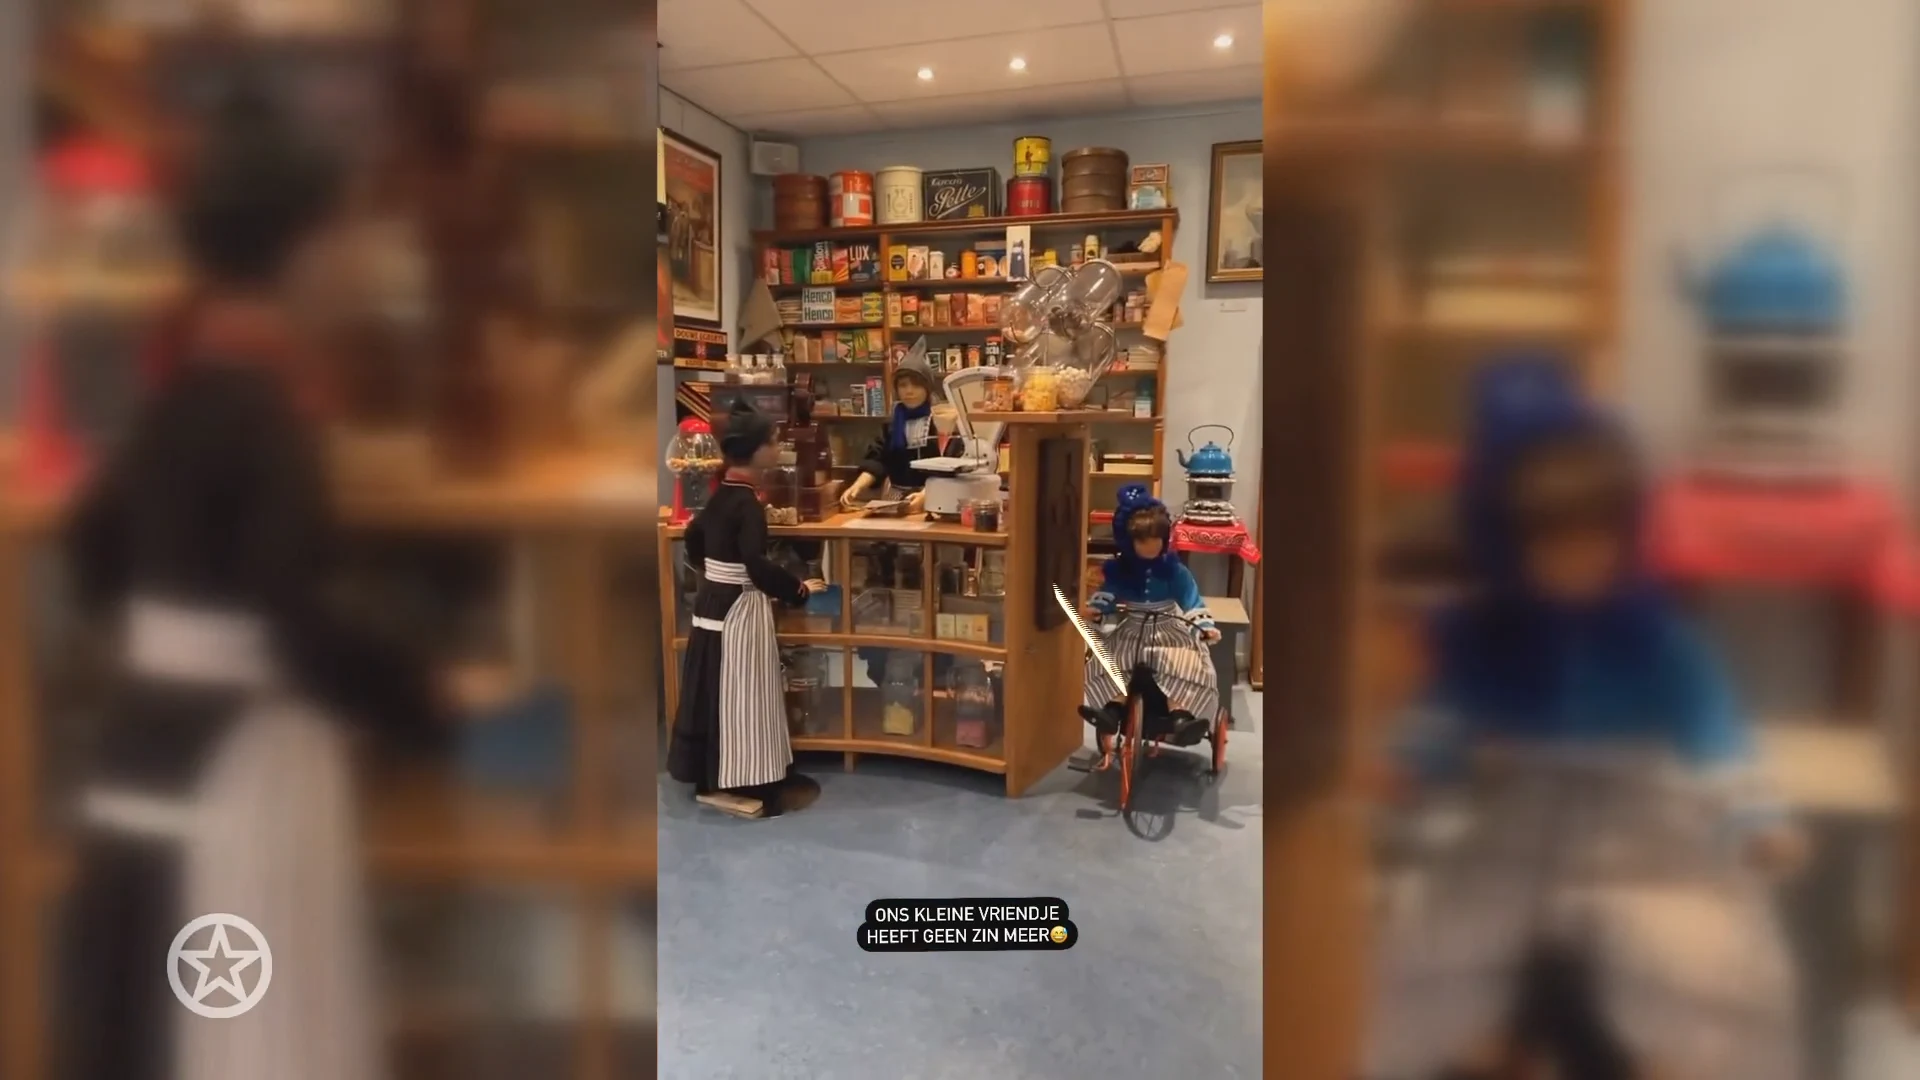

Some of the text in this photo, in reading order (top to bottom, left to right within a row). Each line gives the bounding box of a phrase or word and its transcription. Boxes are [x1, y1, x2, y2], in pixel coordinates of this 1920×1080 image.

[849, 245, 869, 260] LUX
[803, 288, 832, 303] Henco
[804, 307, 833, 321] Henco
